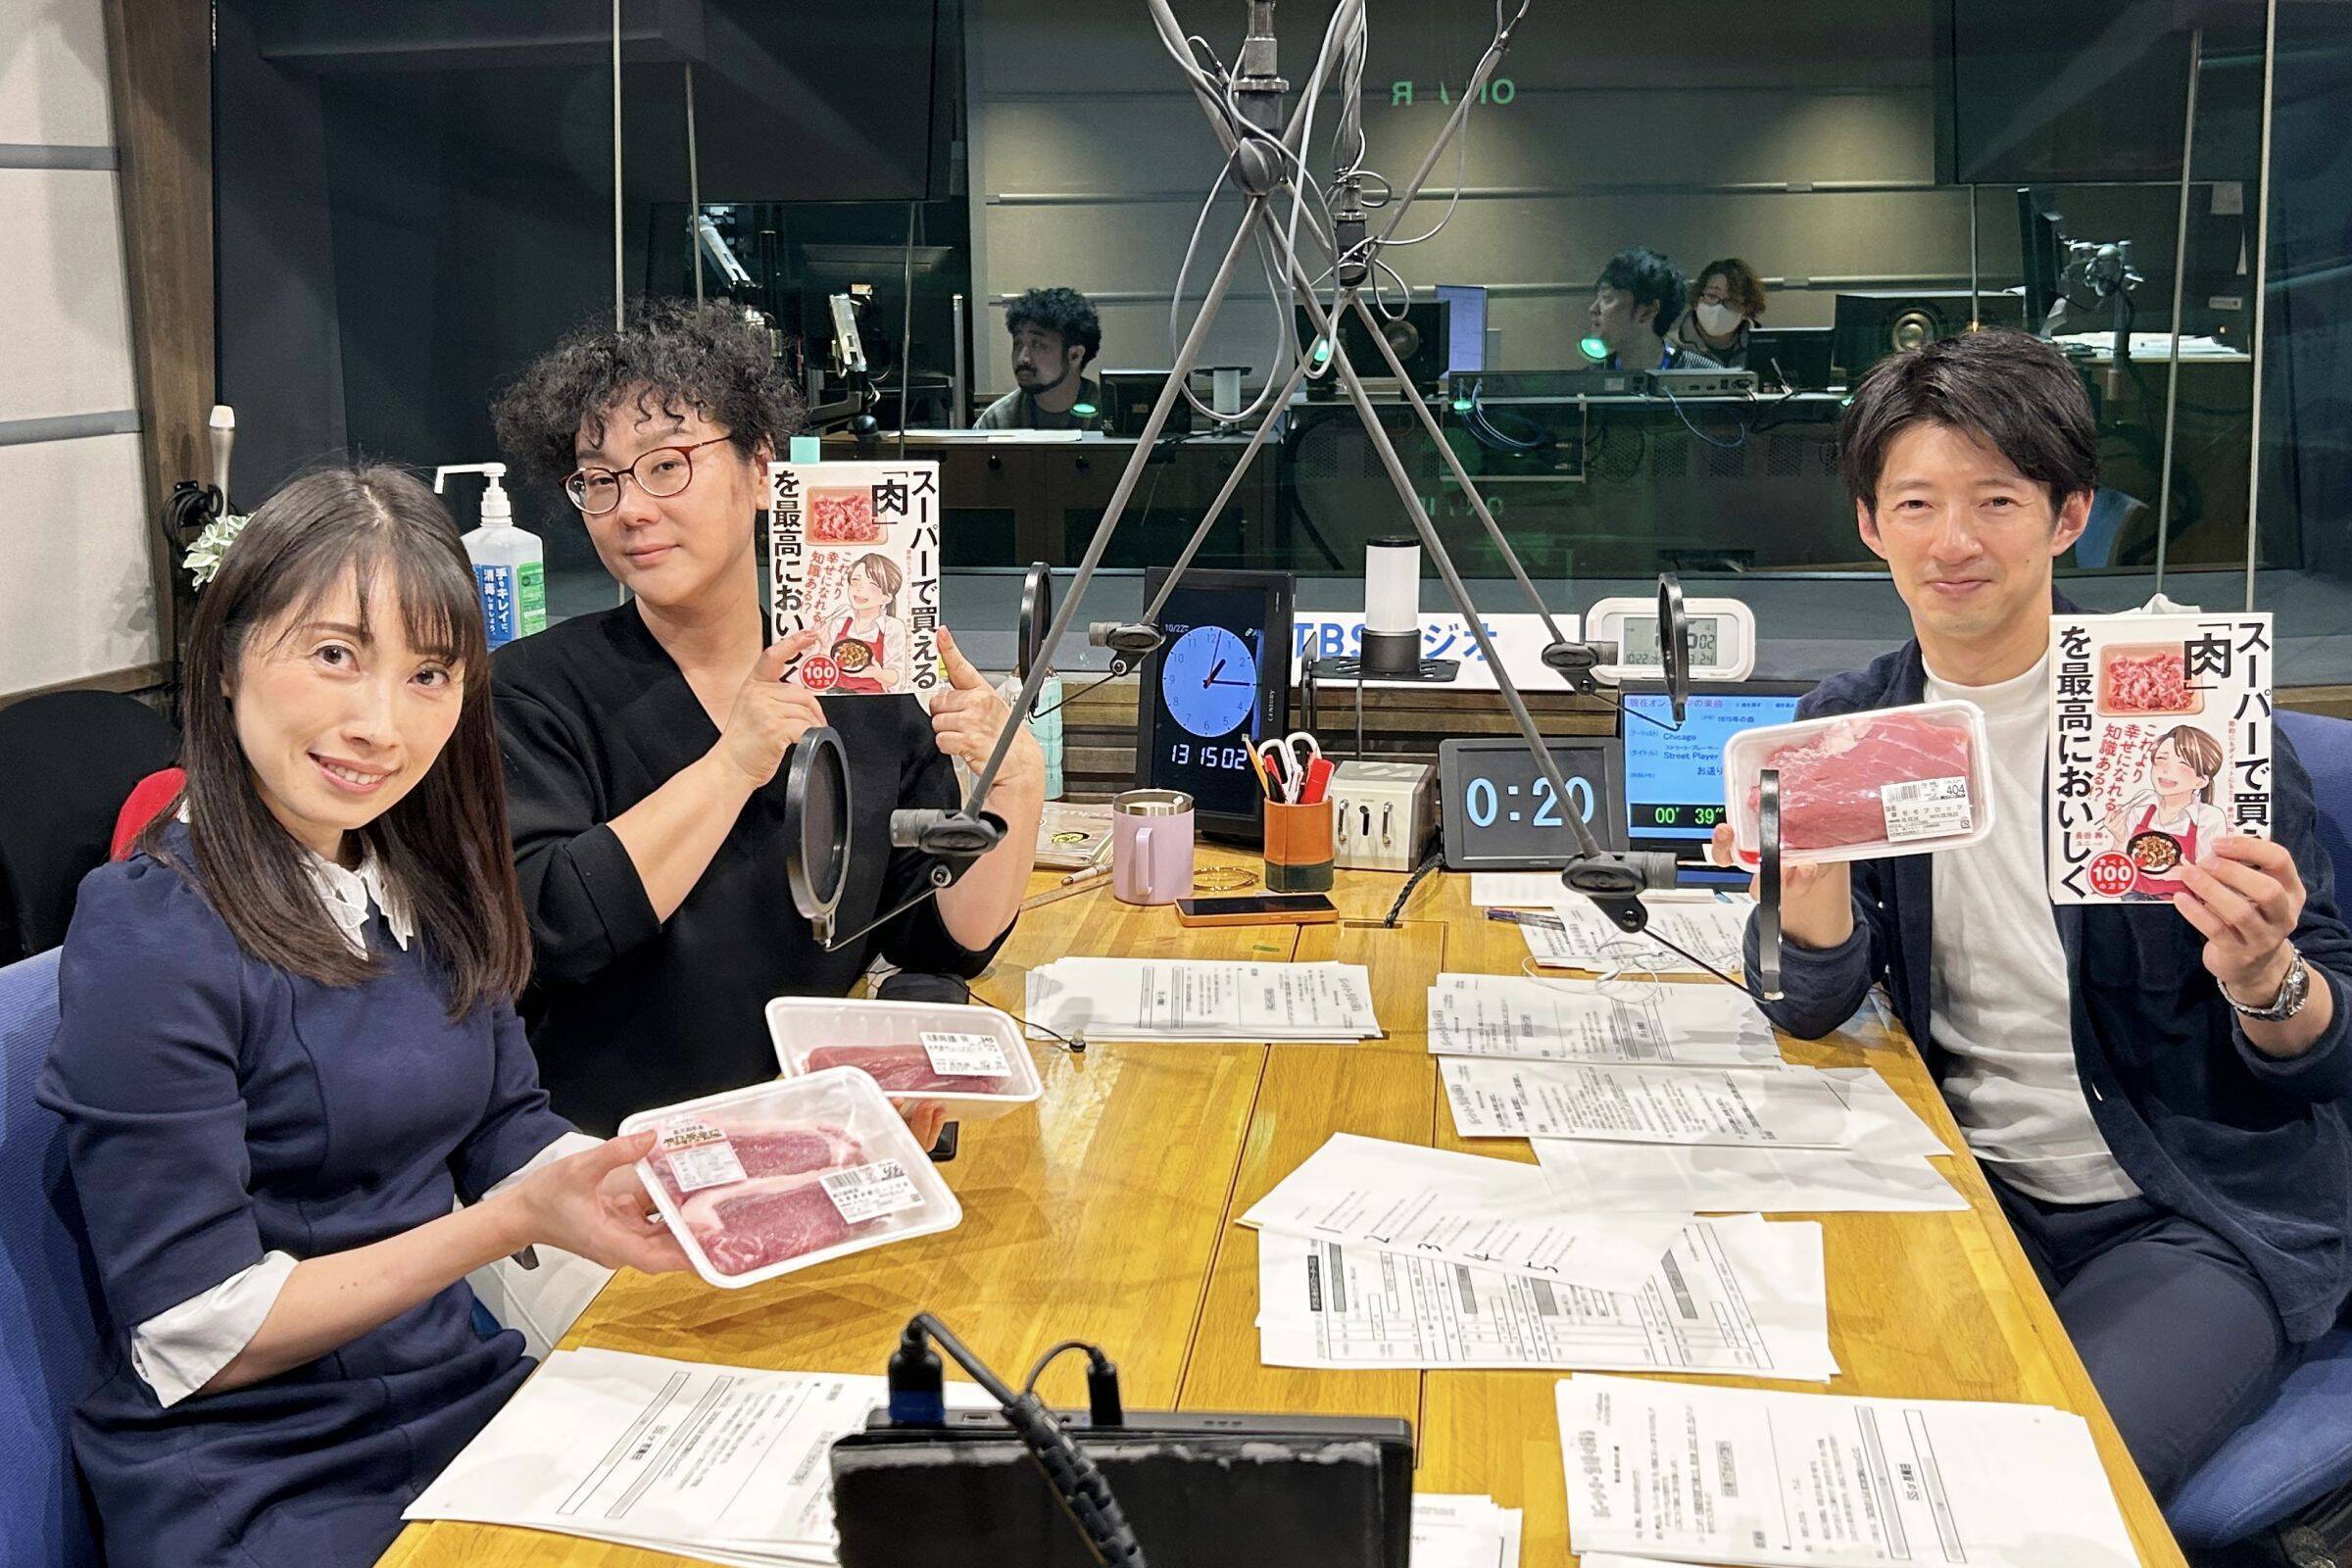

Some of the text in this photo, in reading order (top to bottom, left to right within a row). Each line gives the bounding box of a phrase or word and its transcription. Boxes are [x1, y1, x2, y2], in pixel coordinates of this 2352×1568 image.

[909, 470, 938, 689] スーパーで買える
[804, 666, 835, 679] 100
[2183, 622, 2231, 691] 「肉」
[1663, 733, 1696, 742] Chicago
[2233, 621, 2272, 838] スーパーで買
[1171, 744, 1248, 770] 13 15 02
[1692, 752, 1719, 760] Player
[2056, 625, 2093, 898] を最高においしく
[2105, 724, 2140, 811] 幸せになれる
[1466, 775, 1595, 827] 0:20
[1946, 784, 1966, 795] 404
[2092, 865, 2132, 882] 100
